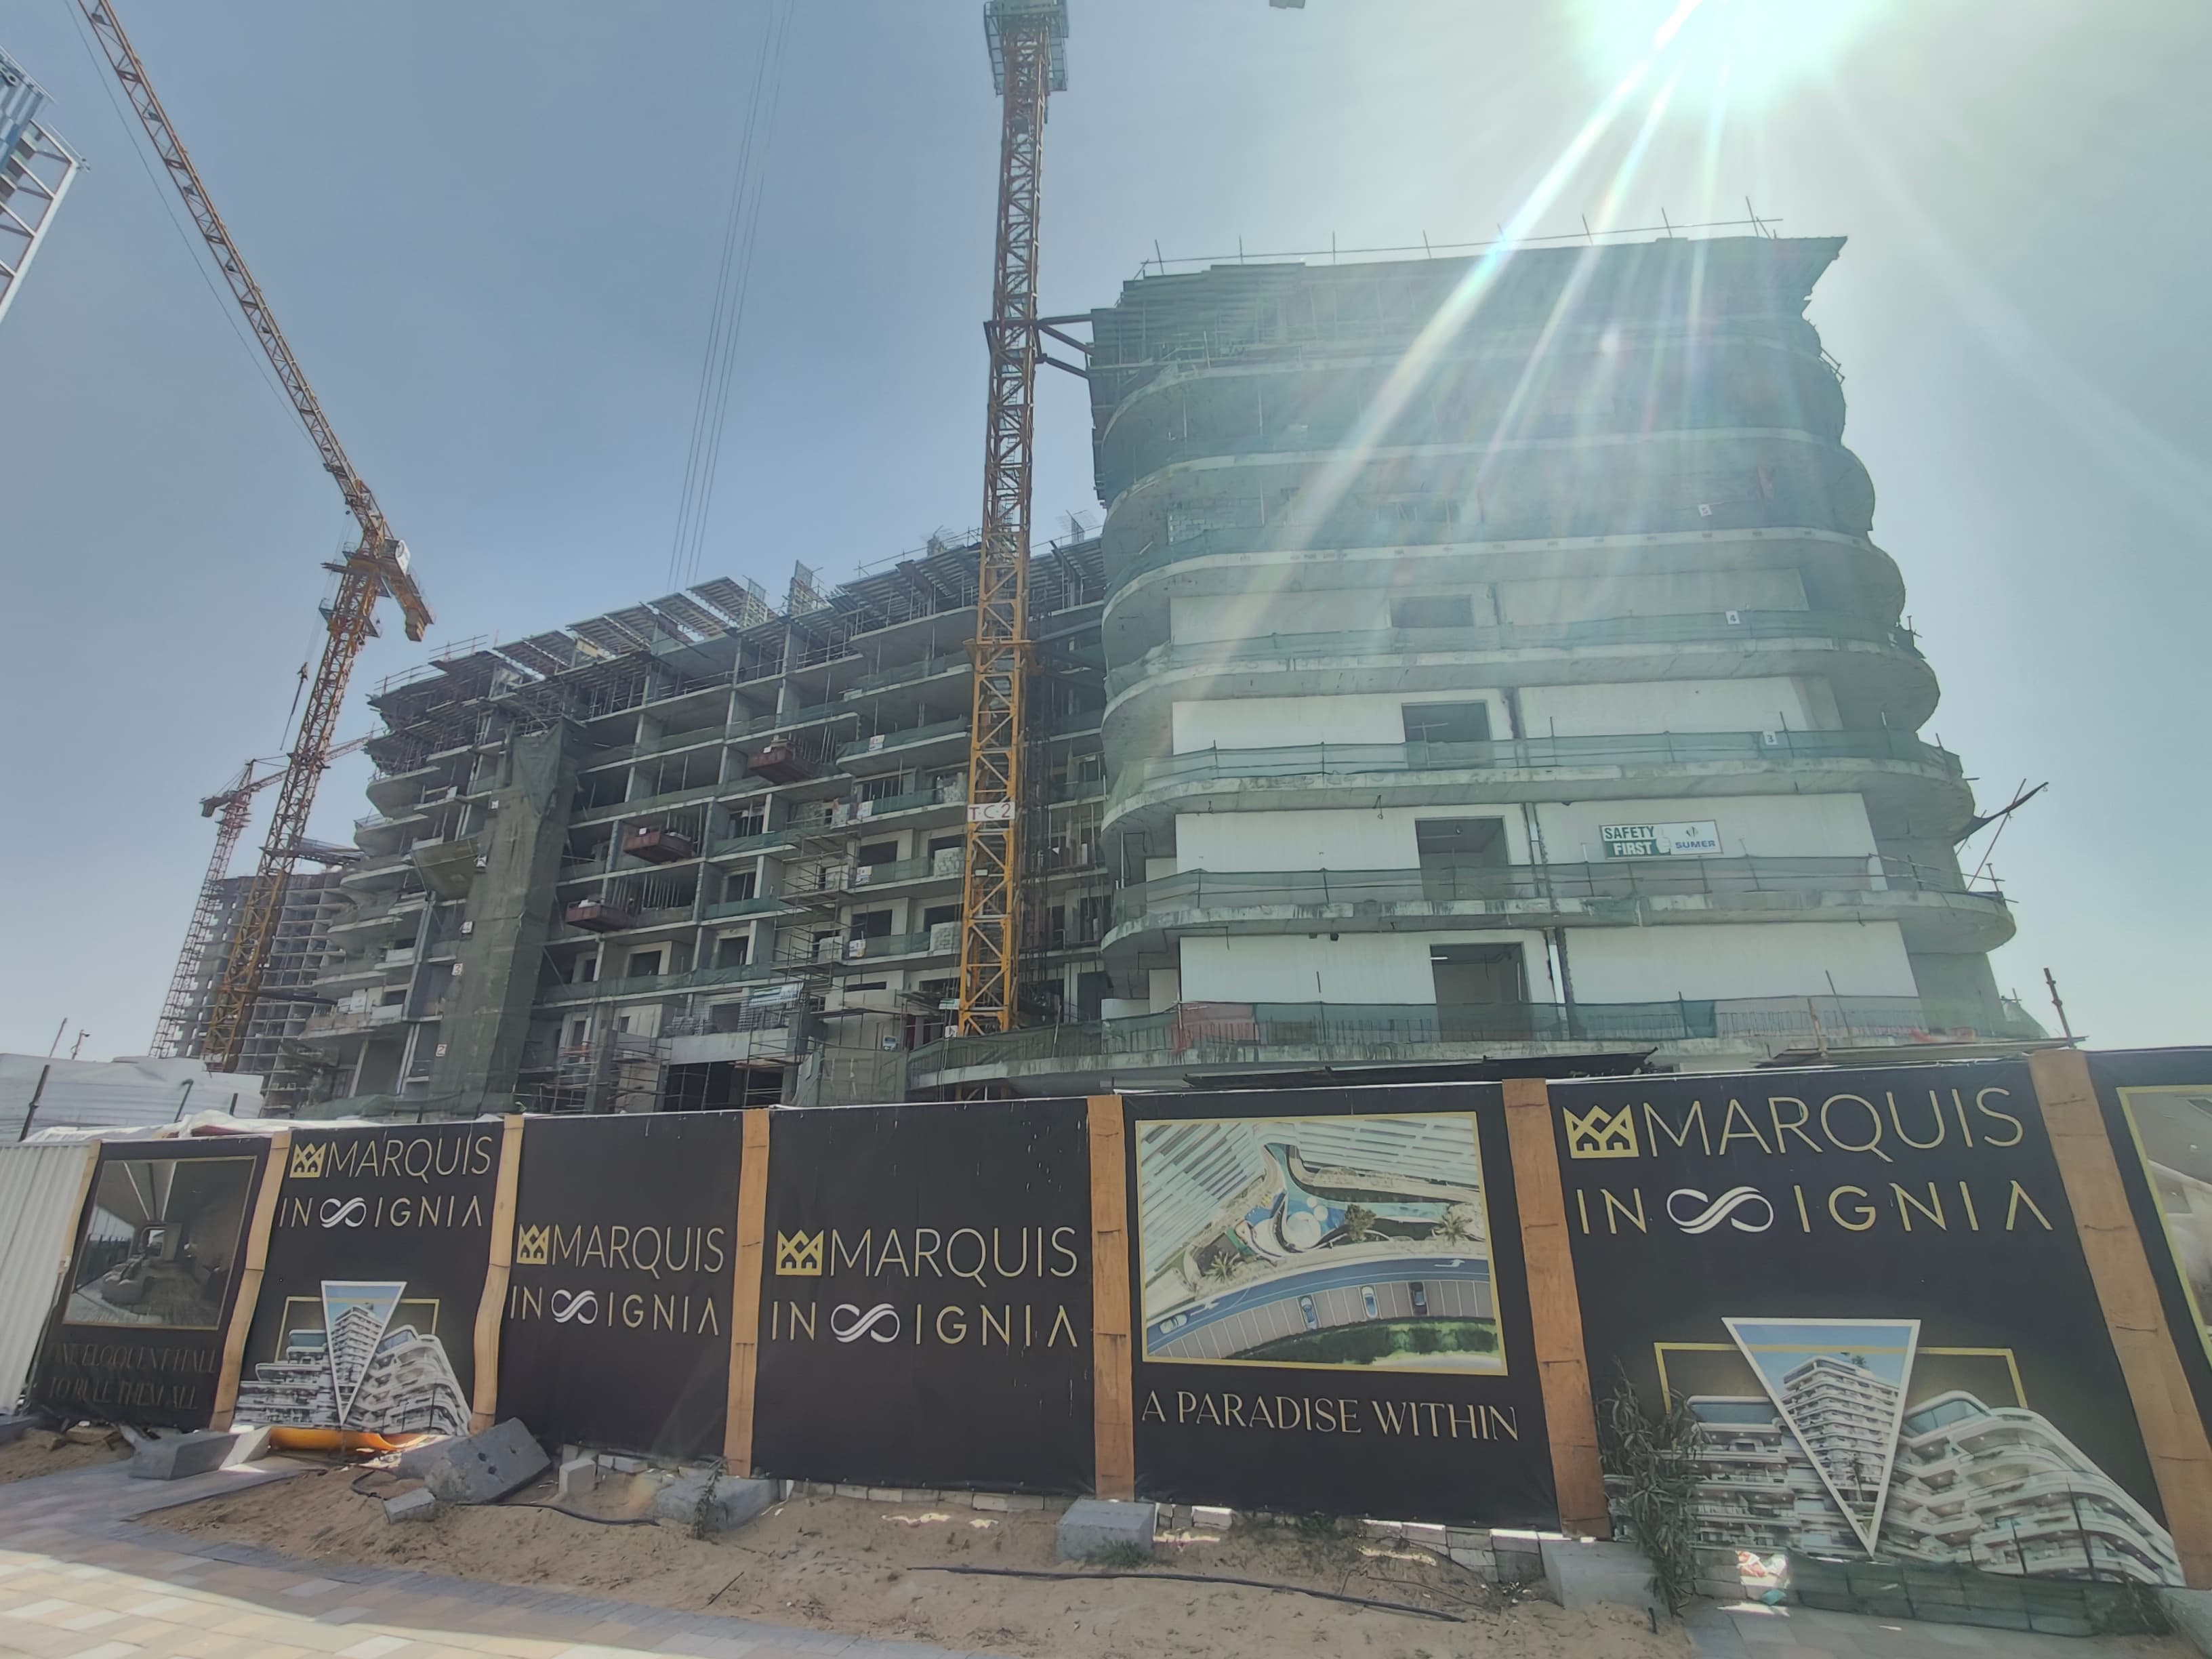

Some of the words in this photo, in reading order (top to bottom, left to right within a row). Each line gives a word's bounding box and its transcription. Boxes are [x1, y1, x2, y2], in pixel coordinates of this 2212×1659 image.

[1729, 614, 1738, 623] 4
[1766, 734, 1775, 743] 3
[1604, 825, 1654, 840] SAFETY
[1613, 842, 1652, 856] FIRST
[1675, 840, 1716, 849] SUMER
[437, 1045, 445, 1055] 2
[1643, 1087, 2023, 1162] MARQUIS
[325, 1136, 492, 1184] MARQUIS
[552, 1223, 724, 1279] MARQUIS
[831, 1227, 1078, 1287] MARQUIS
[1142, 1390, 1166, 1422] A
[1176, 1391, 1361, 1433] PARADISE
[1371, 1400, 1519, 1441] WITHIN
